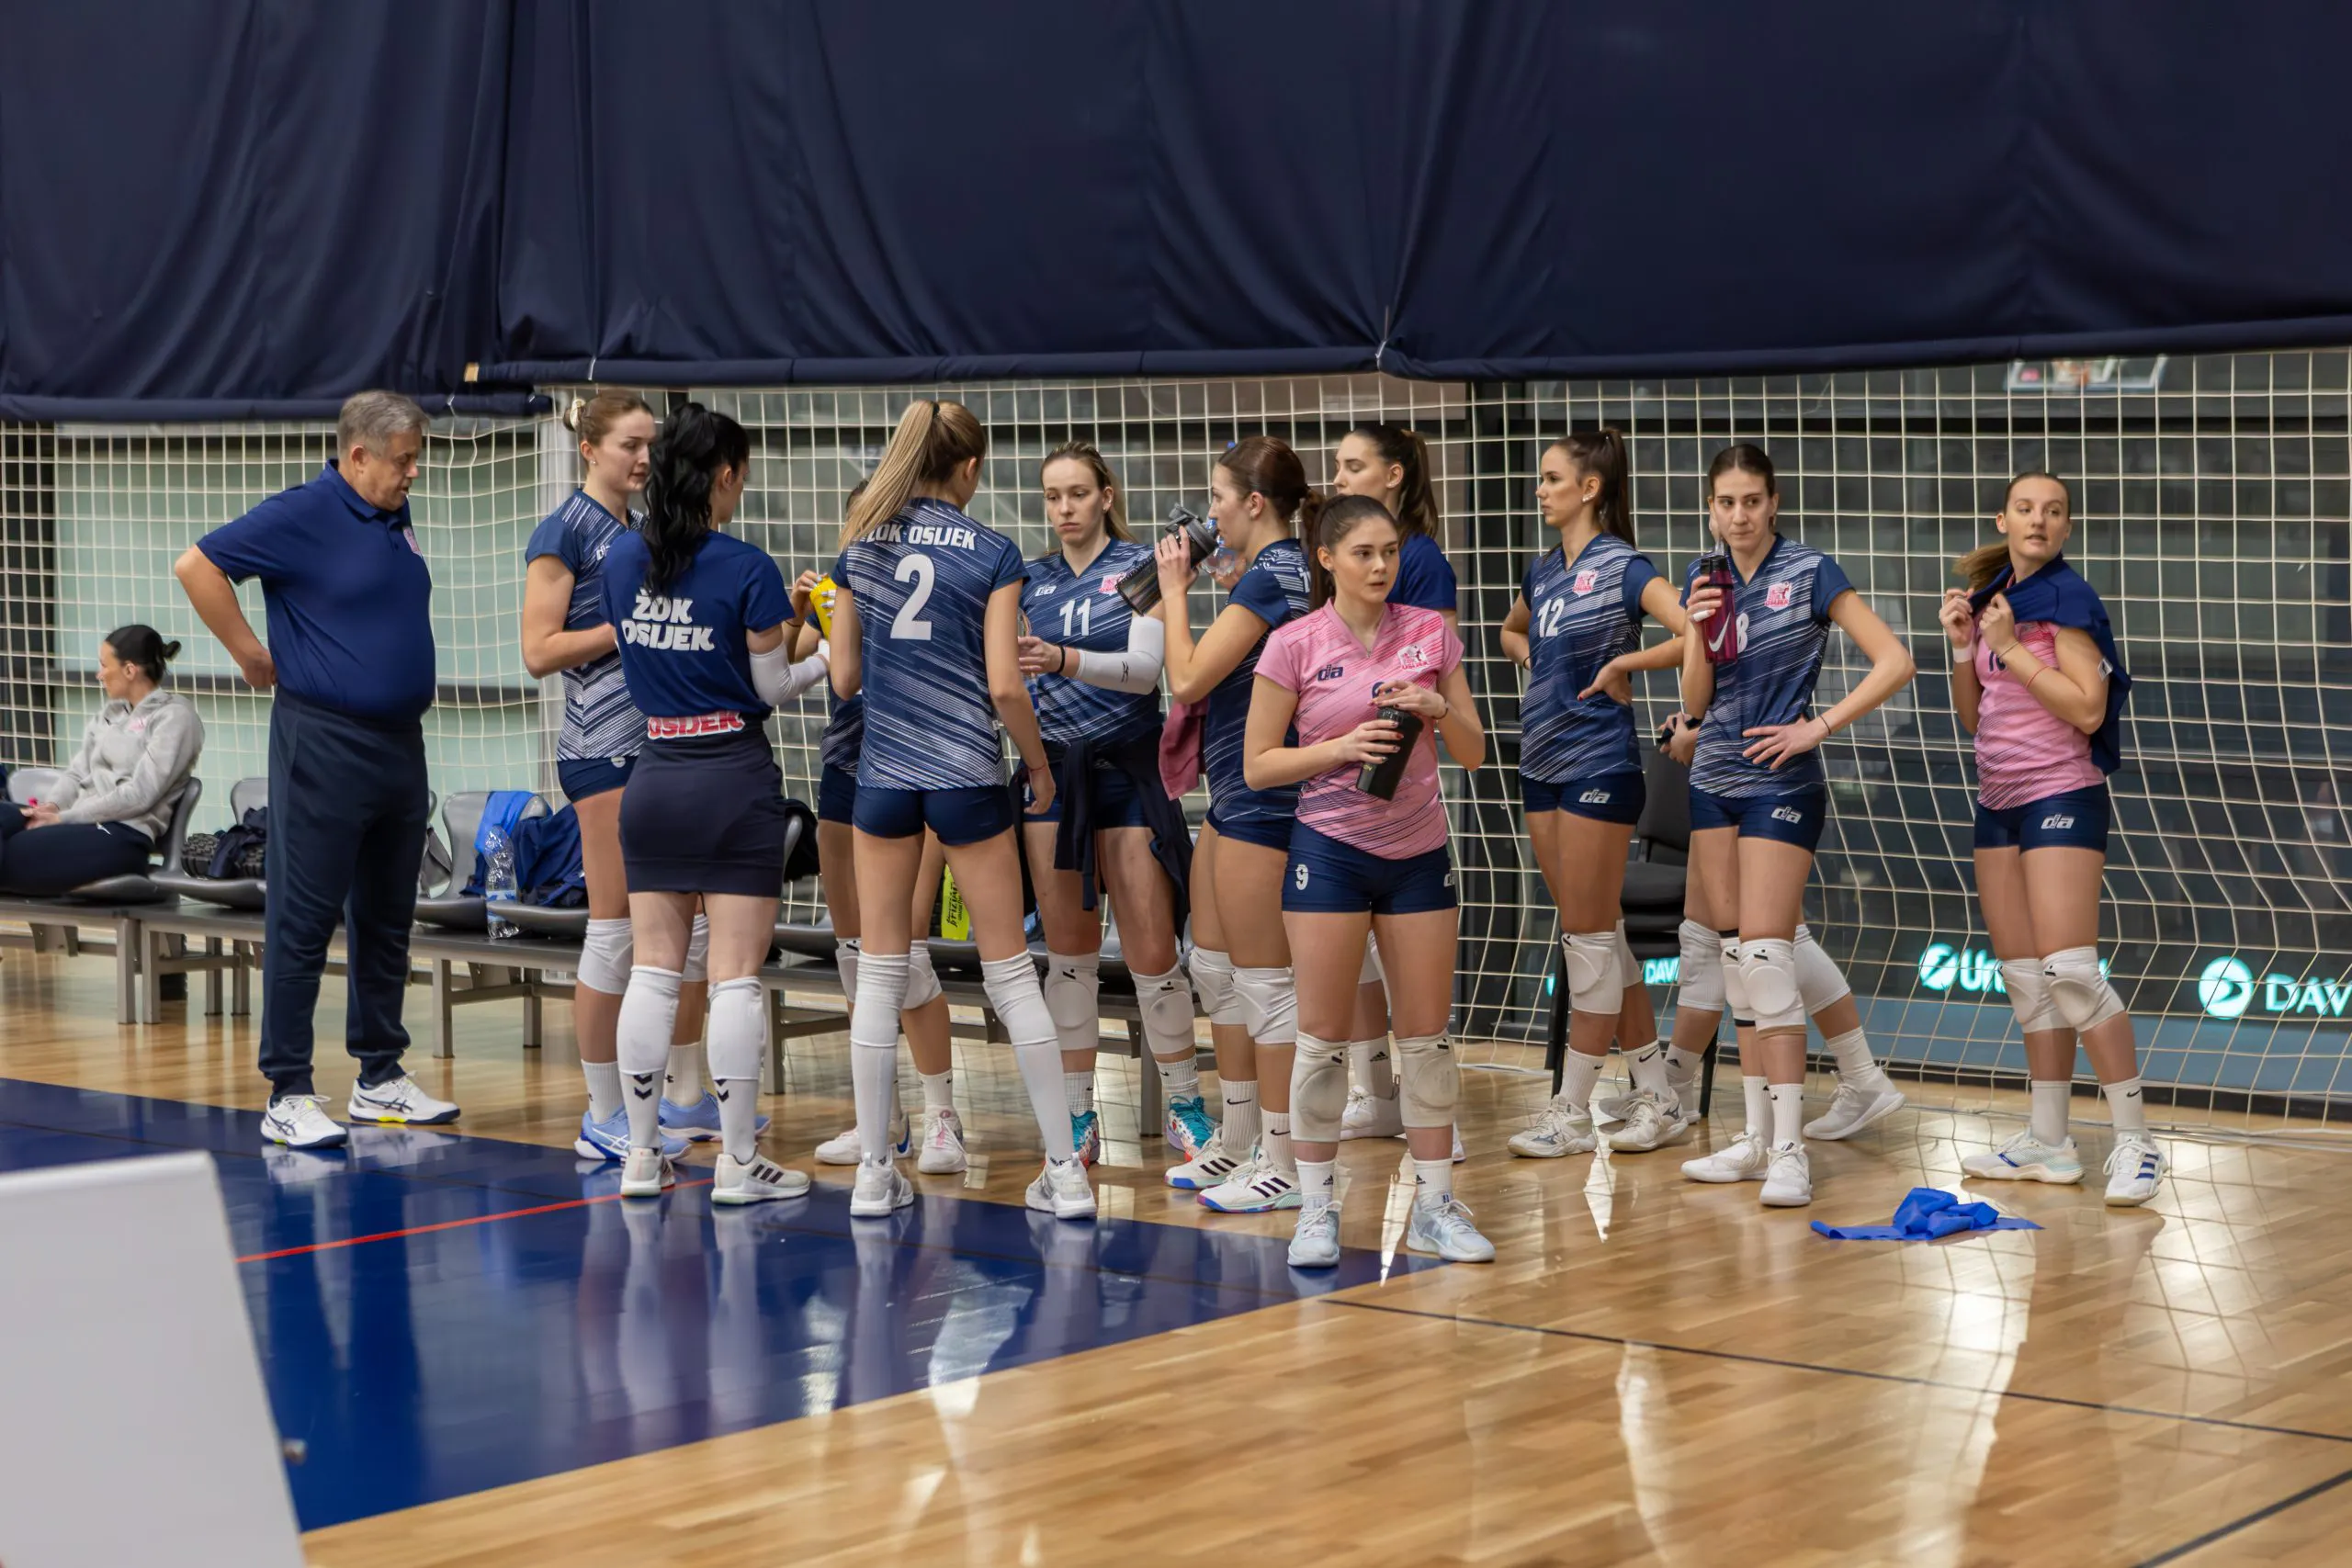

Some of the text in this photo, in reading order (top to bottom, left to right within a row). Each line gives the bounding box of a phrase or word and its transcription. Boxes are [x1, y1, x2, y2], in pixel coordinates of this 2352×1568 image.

[908, 525, 977, 551] OSIJEK
[889, 553, 934, 640] 2
[1059, 598, 1091, 637] 11
[1537, 598, 1565, 637] 12
[621, 619, 715, 651] OSIJEK
[648, 710, 745, 739] OSIJEK
[1295, 864, 1309, 891] 9
[1645, 958, 1679, 984] DAV
